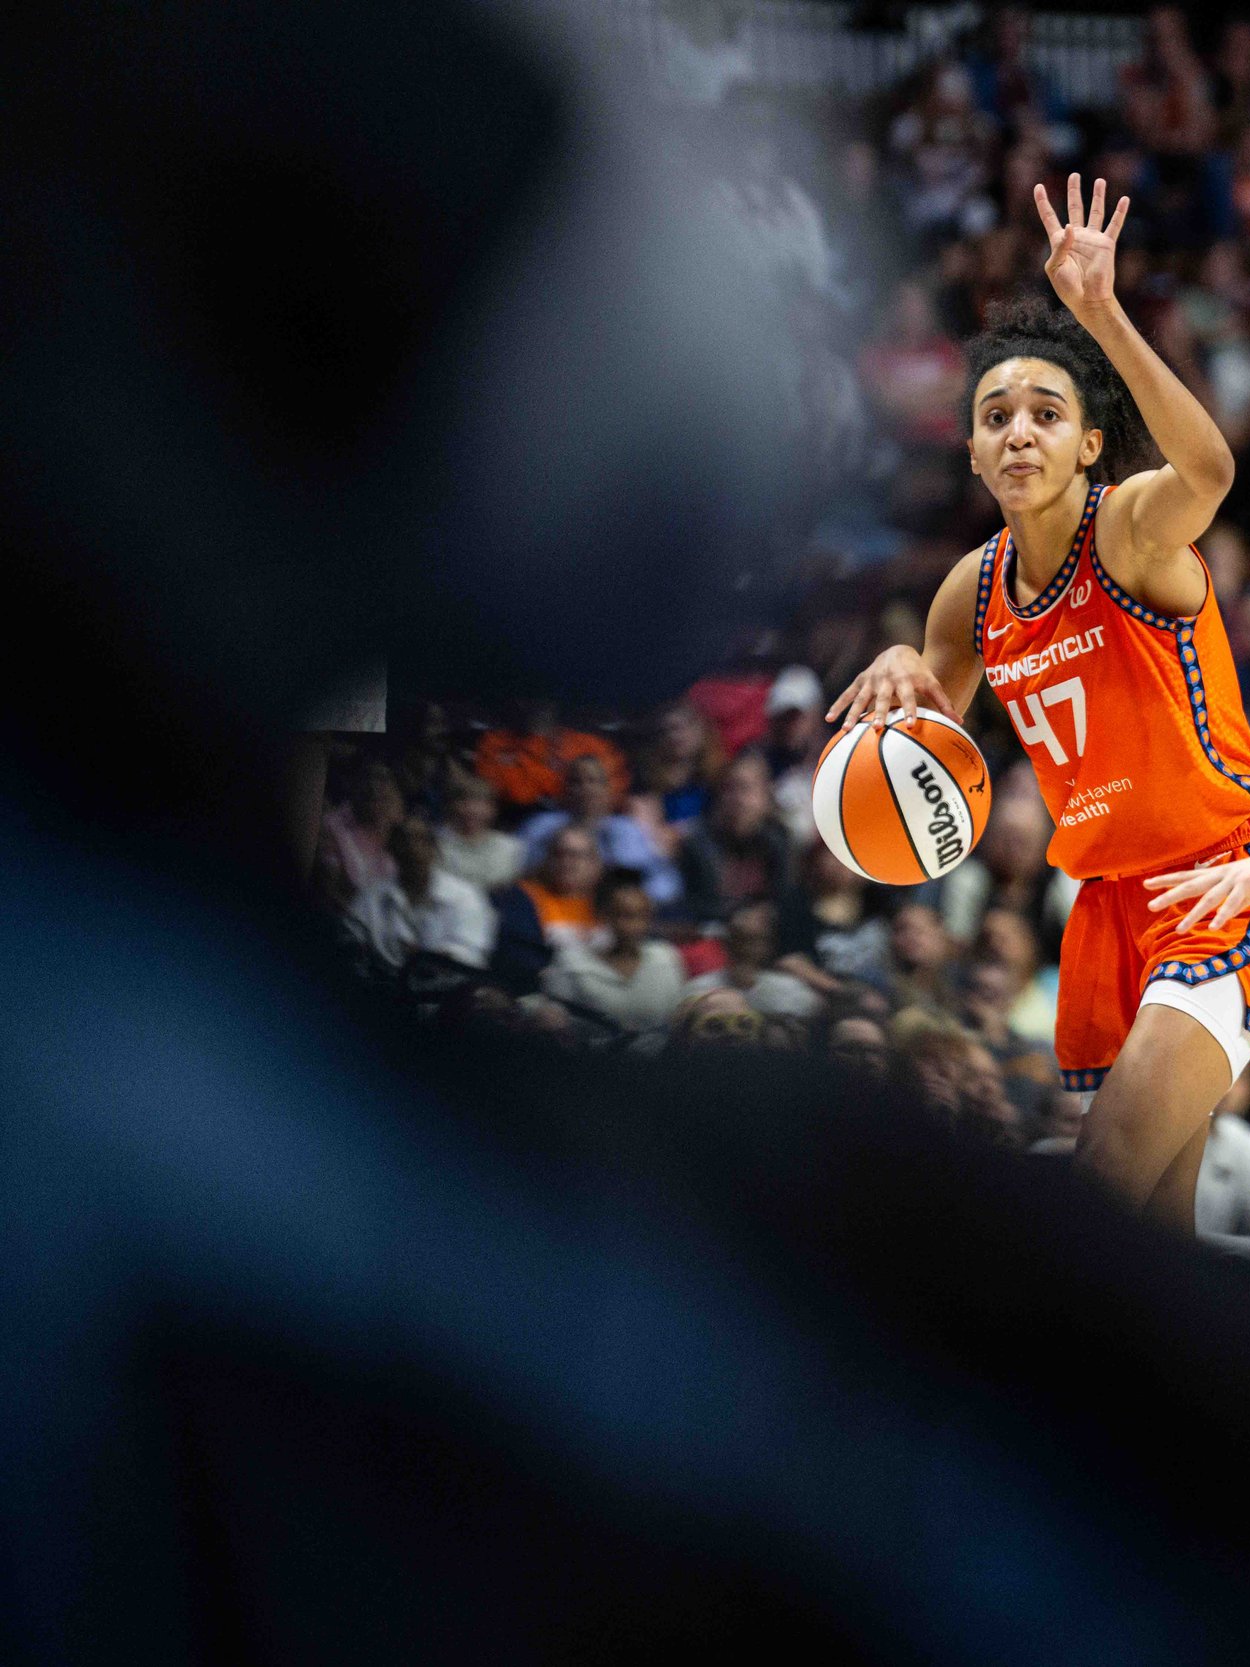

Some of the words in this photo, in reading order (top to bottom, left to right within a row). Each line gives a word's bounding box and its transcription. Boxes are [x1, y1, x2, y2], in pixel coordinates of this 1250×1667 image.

[985, 625, 1105, 687] CONNECTICUT
[1006, 676, 1087, 767] 47
[910, 760, 964, 870] Wilson
[1065, 777, 1133, 809] wHaven
